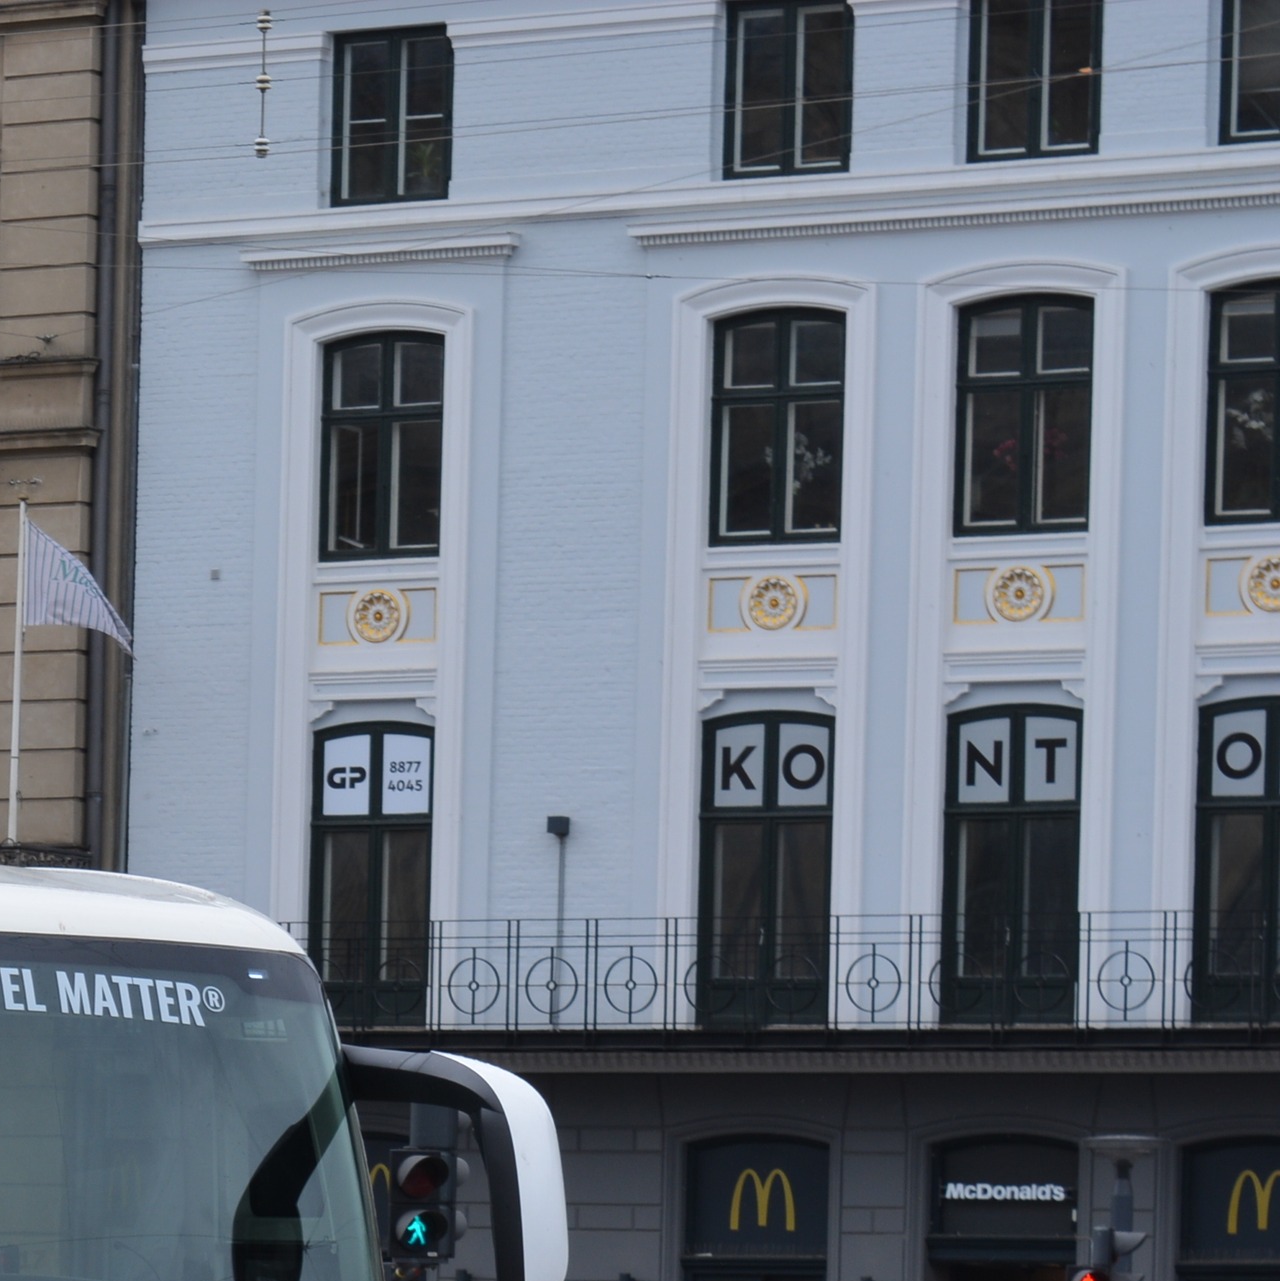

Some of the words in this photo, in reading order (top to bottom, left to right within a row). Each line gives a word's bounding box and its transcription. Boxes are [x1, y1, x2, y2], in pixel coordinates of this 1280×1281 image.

[52, 559, 99, 599] Mag
[389, 761, 422, 773] 8877
[326, 766, 367, 789] GP
[388, 780, 423, 791] 4045
[945, 1182, 1066, 1201] McDonald's
